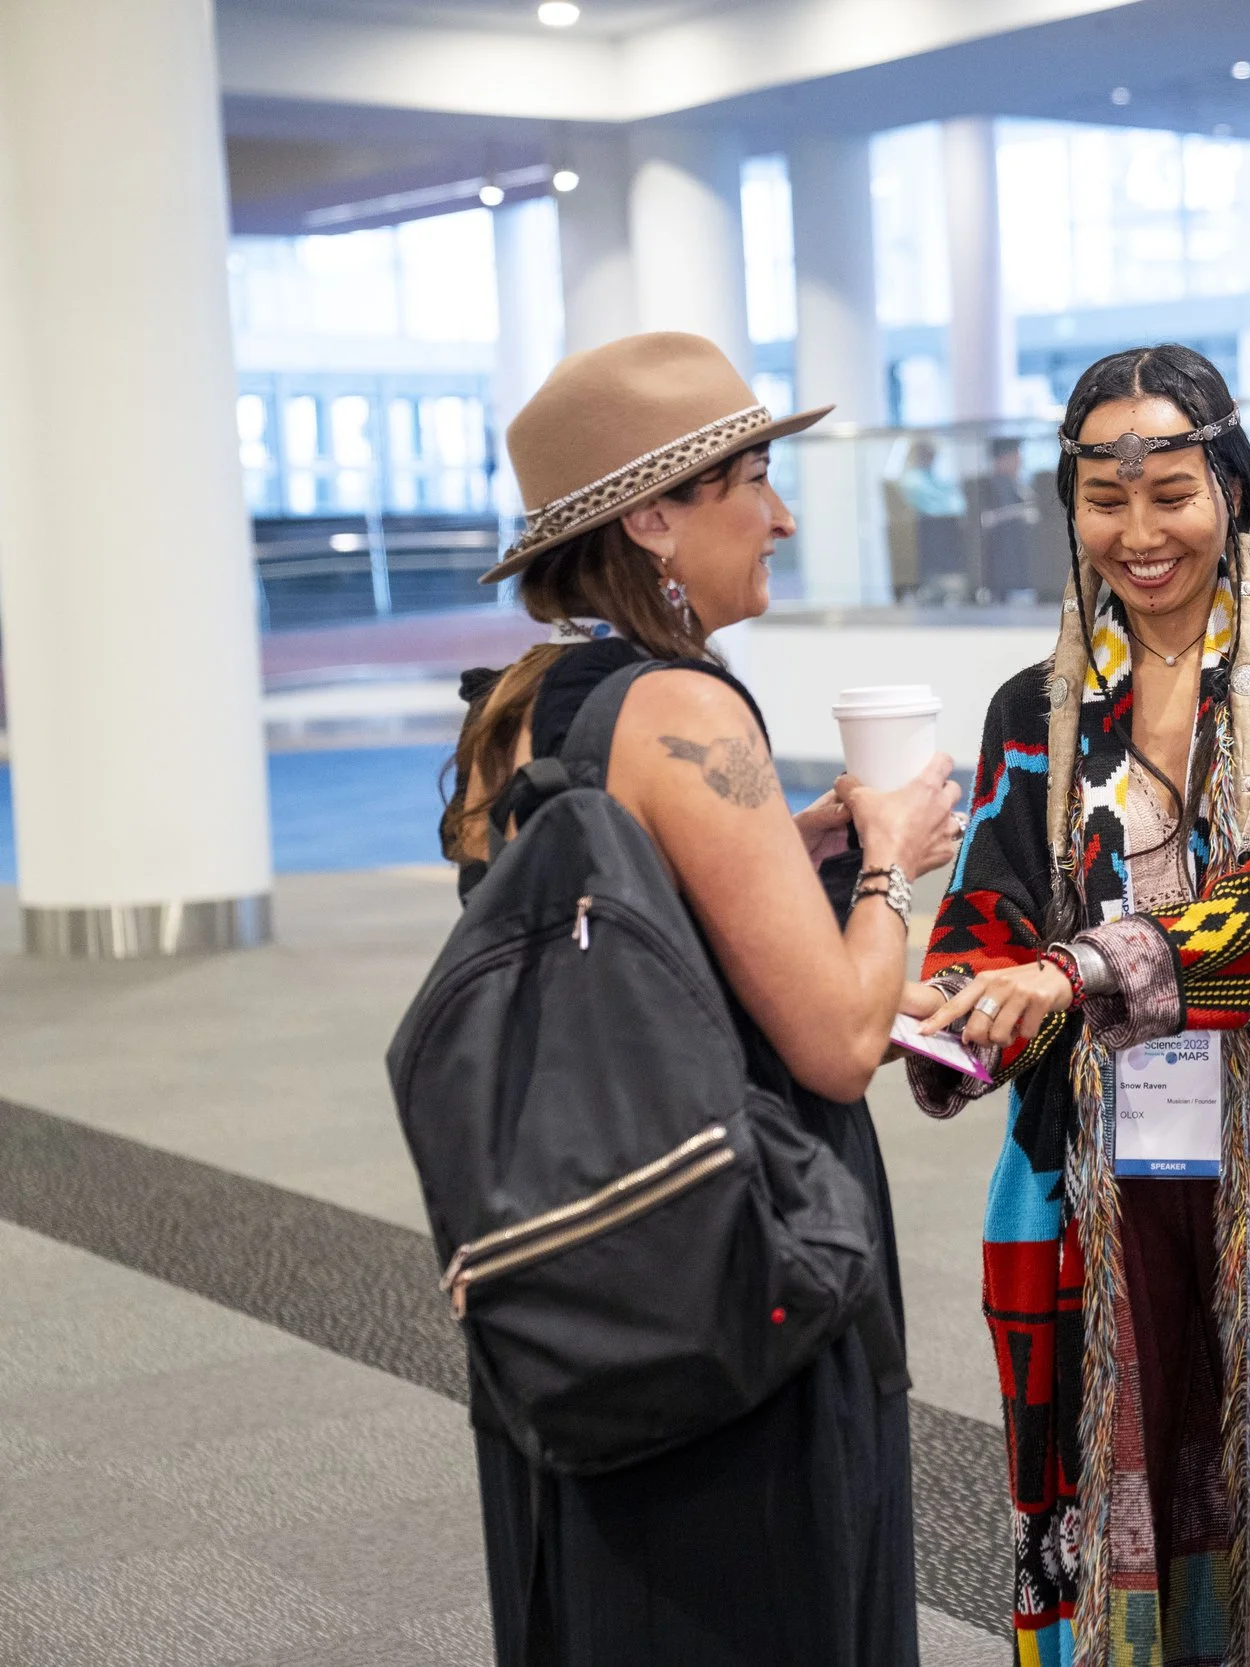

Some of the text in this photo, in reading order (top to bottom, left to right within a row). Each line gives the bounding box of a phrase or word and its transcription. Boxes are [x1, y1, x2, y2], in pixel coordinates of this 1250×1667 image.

[1144, 1039, 1209, 1050] Science 2023
[1178, 1052, 1209, 1061] MAPS
[1120, 1082, 1167, 1090] Snow Raven
[1120, 1111, 1144, 1119] OLOX
[1150, 1163, 1186, 1171] SPEAKER
